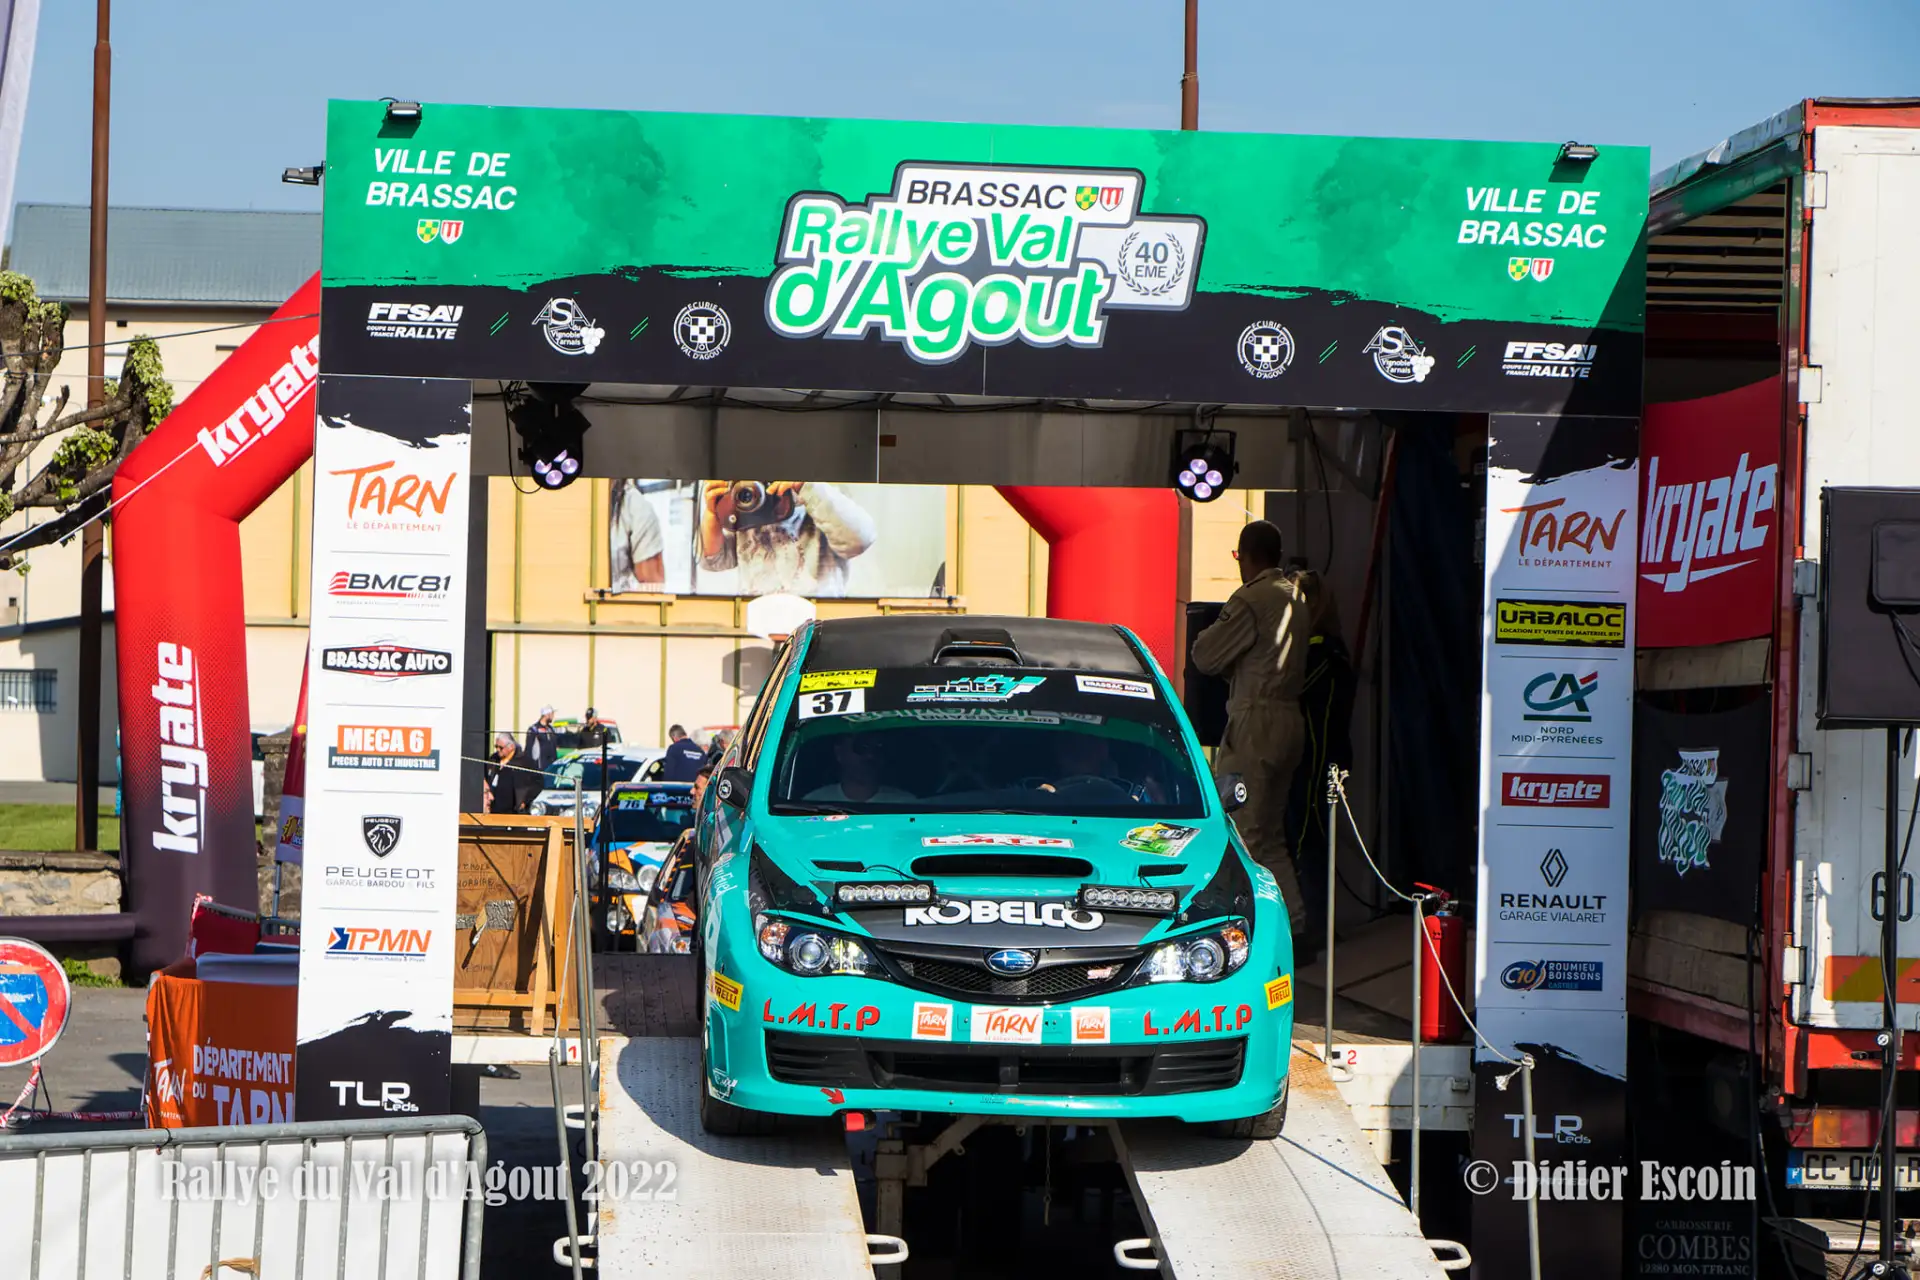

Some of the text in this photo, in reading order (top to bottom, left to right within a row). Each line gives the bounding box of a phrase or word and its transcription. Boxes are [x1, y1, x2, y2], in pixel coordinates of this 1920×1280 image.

[374, 147, 510, 178] VILLE DE
[365, 181, 518, 210] BRASSAC
[907, 179, 1067, 209] BRASSAC
[1466, 187, 1600, 215] VILLE DE
[790, 204, 1074, 264] Rallye Val
[1457, 220, 1607, 249] BRASSAC
[1135, 240, 1169, 264] 40
[1135, 264, 1168, 279] EME
[368, 302, 463, 323] FFSA
[532, 297, 591, 326] ASA
[687, 301, 718, 311] ECURIE
[774, 260, 1104, 354] d'Agout
[394, 326, 457, 340] RALLYE
[551, 330, 581, 340] Vignoble
[1251, 320, 1282, 330] ECURIE
[555, 338, 581, 346] Tarnais
[1362, 326, 1421, 354] ASA
[680, 344, 723, 360] VAL D'AGOUT
[1503, 341, 1597, 361] FFSA
[1244, 363, 1287, 379] VAL D'AGOUT
[1381, 358, 1411, 367] Vignoble
[1530, 365, 1591, 378] RALLYE
[328, 460, 457, 520] TARN
[346, 520, 442, 532] LE DÉPARTEMENT
[1500, 497, 1627, 556] TARN
[1640, 452, 1778, 592] kryate
[1518, 557, 1612, 568] LE DÉPARTEMENT
[348, 573, 451, 591] BMC81
[1501, 609, 1621, 627] URBALOC
[326, 650, 448, 671] BRASSAC AUTO
[1083, 680, 1147, 693] BRASSAC AUTO
[1523, 671, 1598, 712] CA
[812, 691, 852, 715] 37
[343, 727, 425, 753] MECA 6
[1540, 726, 1574, 734] NORD
[151, 641, 209, 854] kryate
[331, 755, 436, 769] PIECES AUTO ET INDUSTRIE
[1509, 776, 1603, 803] kryate
[326, 866, 435, 880] PEUGEOT
[326, 878, 364, 887] GARAGE
[367, 880, 405, 888] BARDOU
[416, 881, 435, 889] FILS
[1500, 893, 1607, 910] RENAULT
[905, 900, 1105, 931] KOBELCO
[1500, 910, 1606, 923] GARAGE VIALARET
[346, 927, 432, 953] TPMN
[1548, 962, 1596, 971] ROUMIEU
[1548, 971, 1601, 981] BOISSONS
[1268, 980, 1291, 1006] PIRELLI
[763, 997, 881, 1032] L.M.T.P
[918, 1009, 947, 1026] TARN
[976, 1007, 1040, 1036] TARN
[1078, 1012, 1105, 1030] TARN
[1144, 1003, 1253, 1036] L.M.T.P
[193, 1037, 292, 1085] DÉPARTEMENT
[568, 1045, 577, 1060] 1
[1347, 1049, 1358, 1065] 2
[192, 1081, 207, 1100] DU
[330, 1081, 411, 1107] TLR
[213, 1084, 294, 1127] TARN
[383, 1101, 419, 1112] Leds
[1557, 1133, 1592, 1144] Leds
[1638, 1234, 1751, 1261] COMBES
